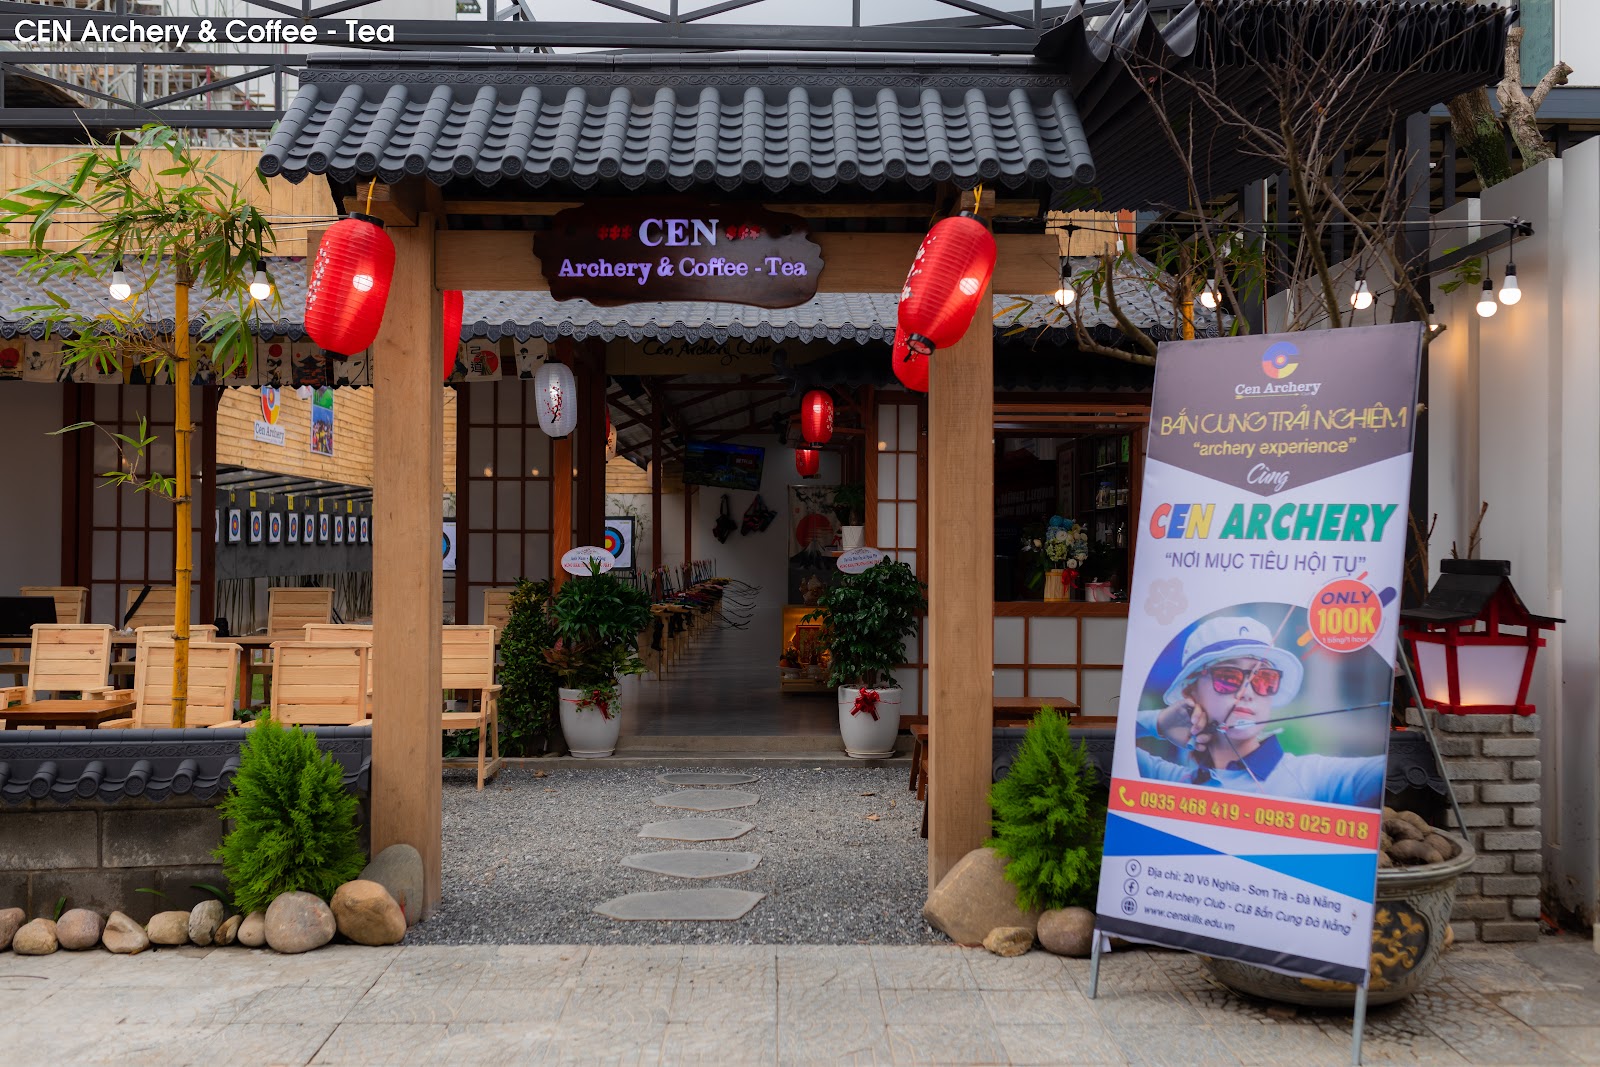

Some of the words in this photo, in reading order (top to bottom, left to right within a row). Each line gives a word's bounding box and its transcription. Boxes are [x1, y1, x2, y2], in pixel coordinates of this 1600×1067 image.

[638, 218, 719, 247] CEN
[558, 258, 652, 285] Archery
[657, 256, 674, 277] &
[678, 257, 748, 277] Coffee
[764, 257, 807, 277] Tea
[643, 340, 673, 355] Cen
[676, 340, 739, 366] Archery
[1235, 384, 1261, 395] Cen
[1263, 381, 1322, 396] Archery
[1160, 407, 1199, 436] BẮN
[1200, 411, 1268, 434] CUNG
[1268, 403, 1310, 431] TRẢI
[1314, 401, 1407, 433] NGHIỆM
[1246, 463, 1291, 492] Cùng
[1150, 503, 1216, 539] CEN
[1219, 503, 1399, 542] ARCHERY
[1205, 552, 1245, 572] MỤC
[1249, 550, 1289, 570] TIÊU
[1294, 551, 1326, 575] HỘI
[1321, 590, 1374, 605] ONLY
[1318, 606, 1376, 635] 100K
[1140, 791, 1176, 811] 0935
[1179, 797, 1207, 816] 468
[1210, 801, 1240, 821] 419
[1254, 807, 1295, 829] 0983
[1299, 813, 1331, 835] 025
[1335, 818, 1369, 840] 018
[1147, 866, 1162, 879] Địa
[1183, 872, 1195, 884] 20
[1196, 874, 1210, 887] Võ
[1211, 878, 1240, 892] Nghĩa
[1248, 884, 1270, 898] Sơn
[1272, 888, 1288, 901] Trà
[1296, 893, 1311, 905] Đà
[1313, 895, 1341, 913] Nẵng
[1145, 886, 1164, 898] Cen
[1165, 890, 1202, 906] Archery
[1203, 897, 1226, 910] Club
[1234, 903, 1252, 915] CLB
[1254, 905, 1273, 919] Bắn
[1275, 911, 1303, 927] Cung
[1305, 916, 1320, 928] Đà
[1321, 919, 1352, 936] Nẵng
